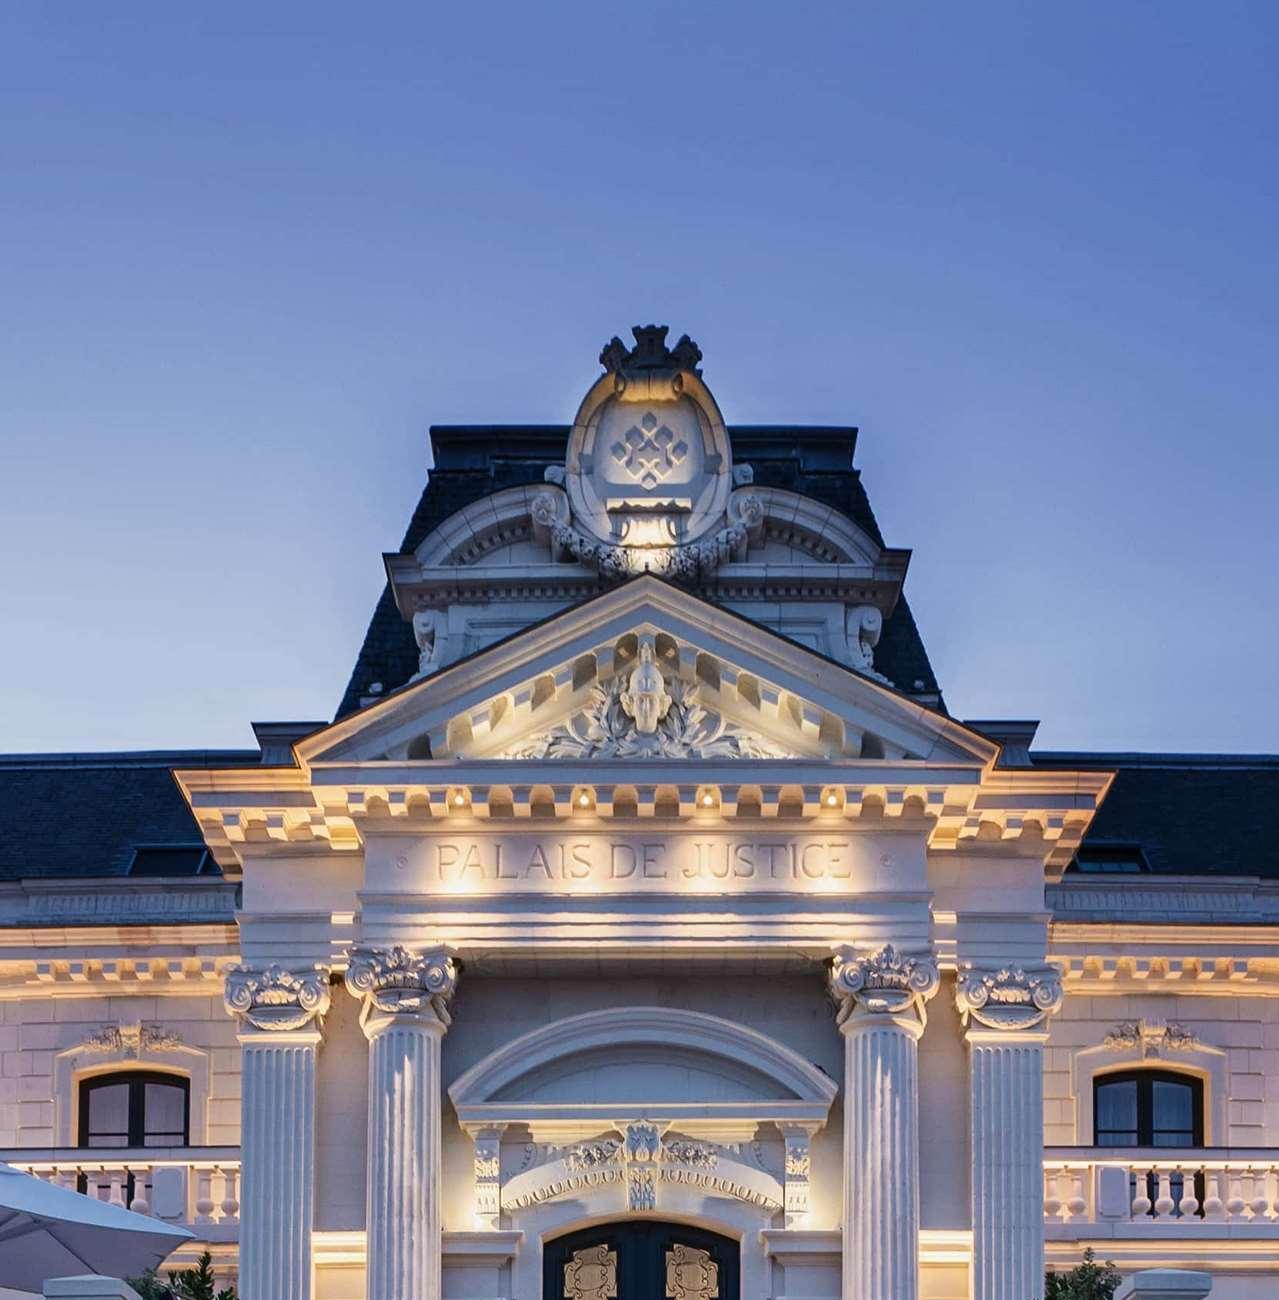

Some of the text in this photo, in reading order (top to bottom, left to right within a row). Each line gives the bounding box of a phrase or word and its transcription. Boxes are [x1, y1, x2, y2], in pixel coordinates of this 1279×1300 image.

[435, 843, 852, 880] PALAIS DE JUSTICE
